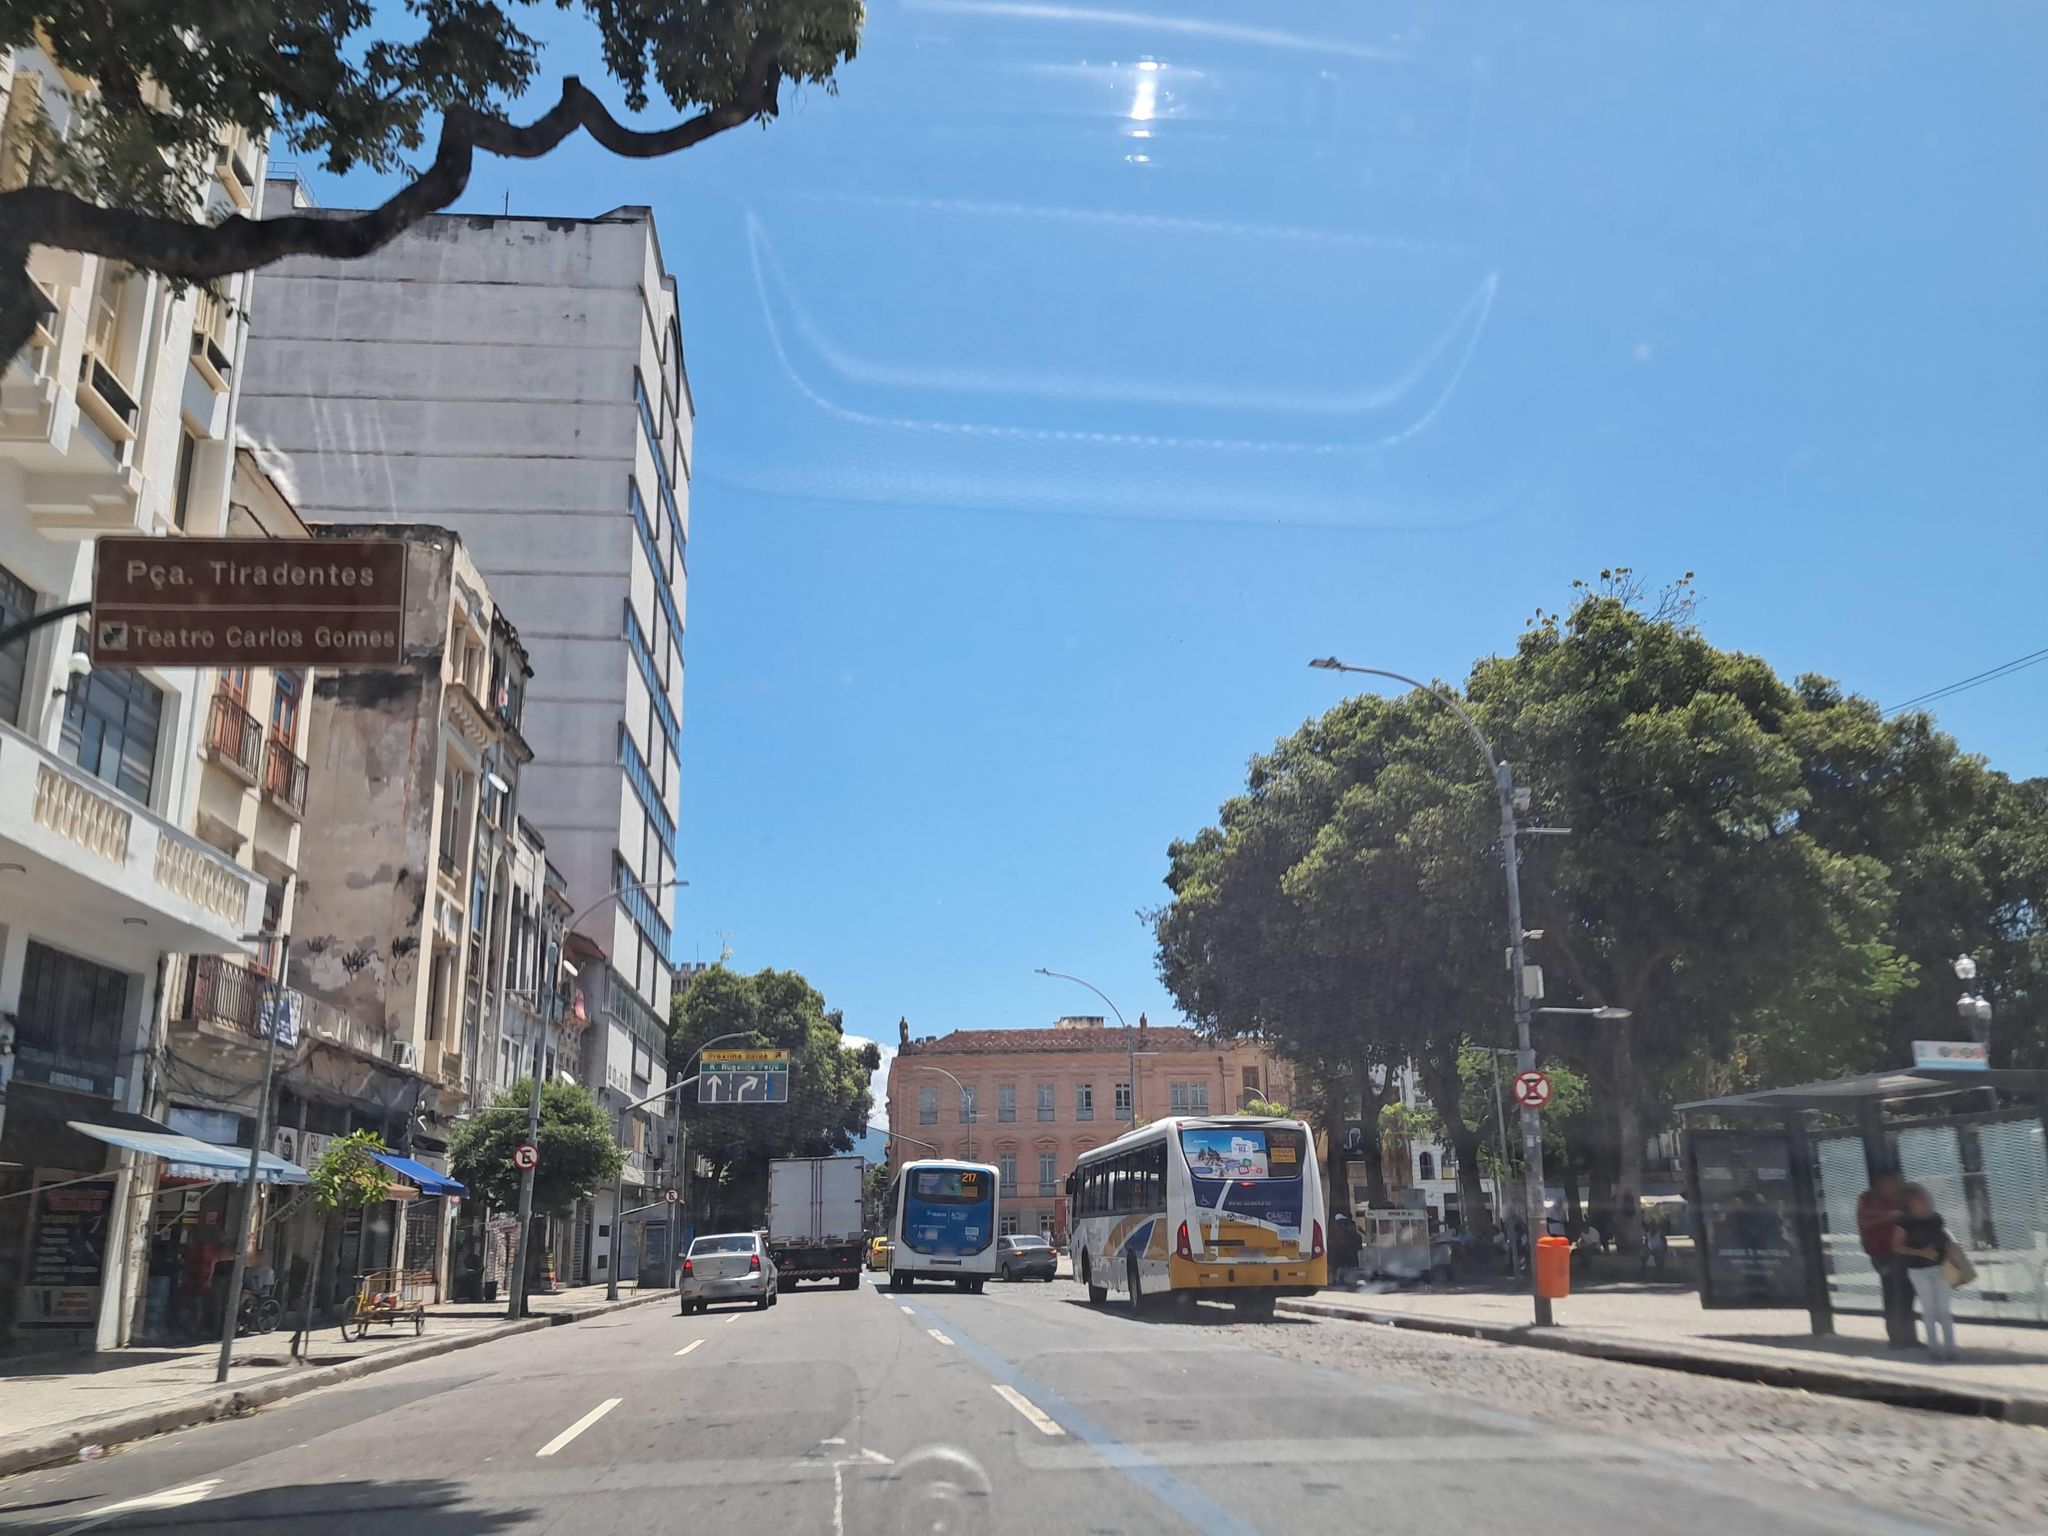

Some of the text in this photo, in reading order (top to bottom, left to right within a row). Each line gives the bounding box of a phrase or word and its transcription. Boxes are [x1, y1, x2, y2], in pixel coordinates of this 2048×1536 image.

[126, 559, 375, 592] Pça. Tiradentes
[132, 624, 396, 649] Teatro Carlos Gomes
[961, 1172, 977, 1183] 217
